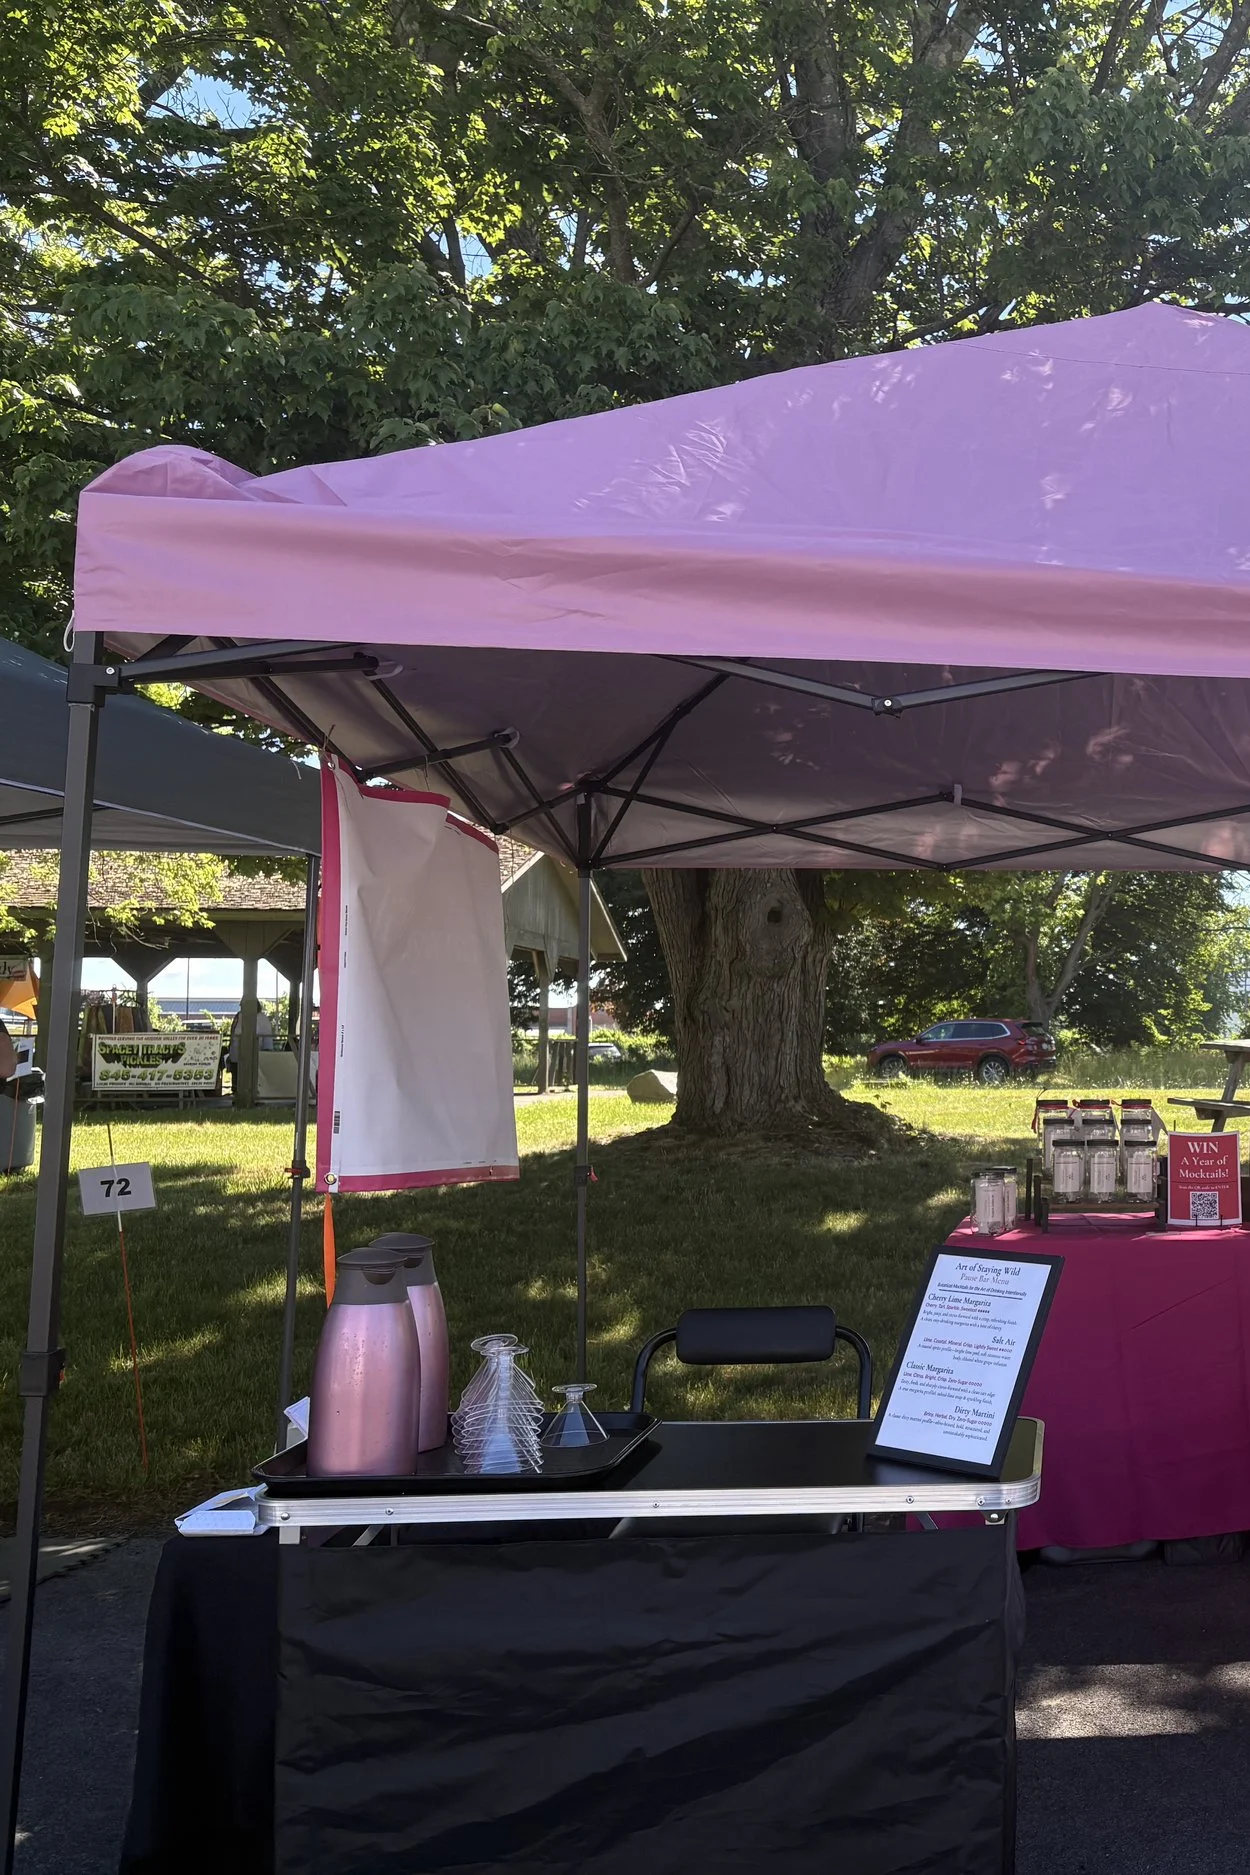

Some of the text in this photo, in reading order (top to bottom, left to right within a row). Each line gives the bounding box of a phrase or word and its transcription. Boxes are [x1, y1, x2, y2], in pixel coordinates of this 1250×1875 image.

[98, 1042, 186, 1054] SPACEY TRACY'S
[120, 1055, 162, 1065] PICKLES
[1188, 1142, 1218, 1153] WIN
[1181, 1155, 1229, 1166] A Year of
[1179, 1169, 1229, 1178] Mocktails!
[100, 1178, 132, 1197] 72
[968, 1262, 978, 1271] of
[975, 1264, 1002, 1276] Staying
[1002, 1266, 1021, 1276] Wild
[960, 1273, 978, 1281] Pause
[991, 1276, 1010, 1284] Menu
[926, 1293, 991, 1308] Cherry Lime Margarita
[991, 1335, 1004, 1344] Salt
[905, 1360, 954, 1376] Classic Margarita
[953, 1405, 995, 1419] Dirty Martini
